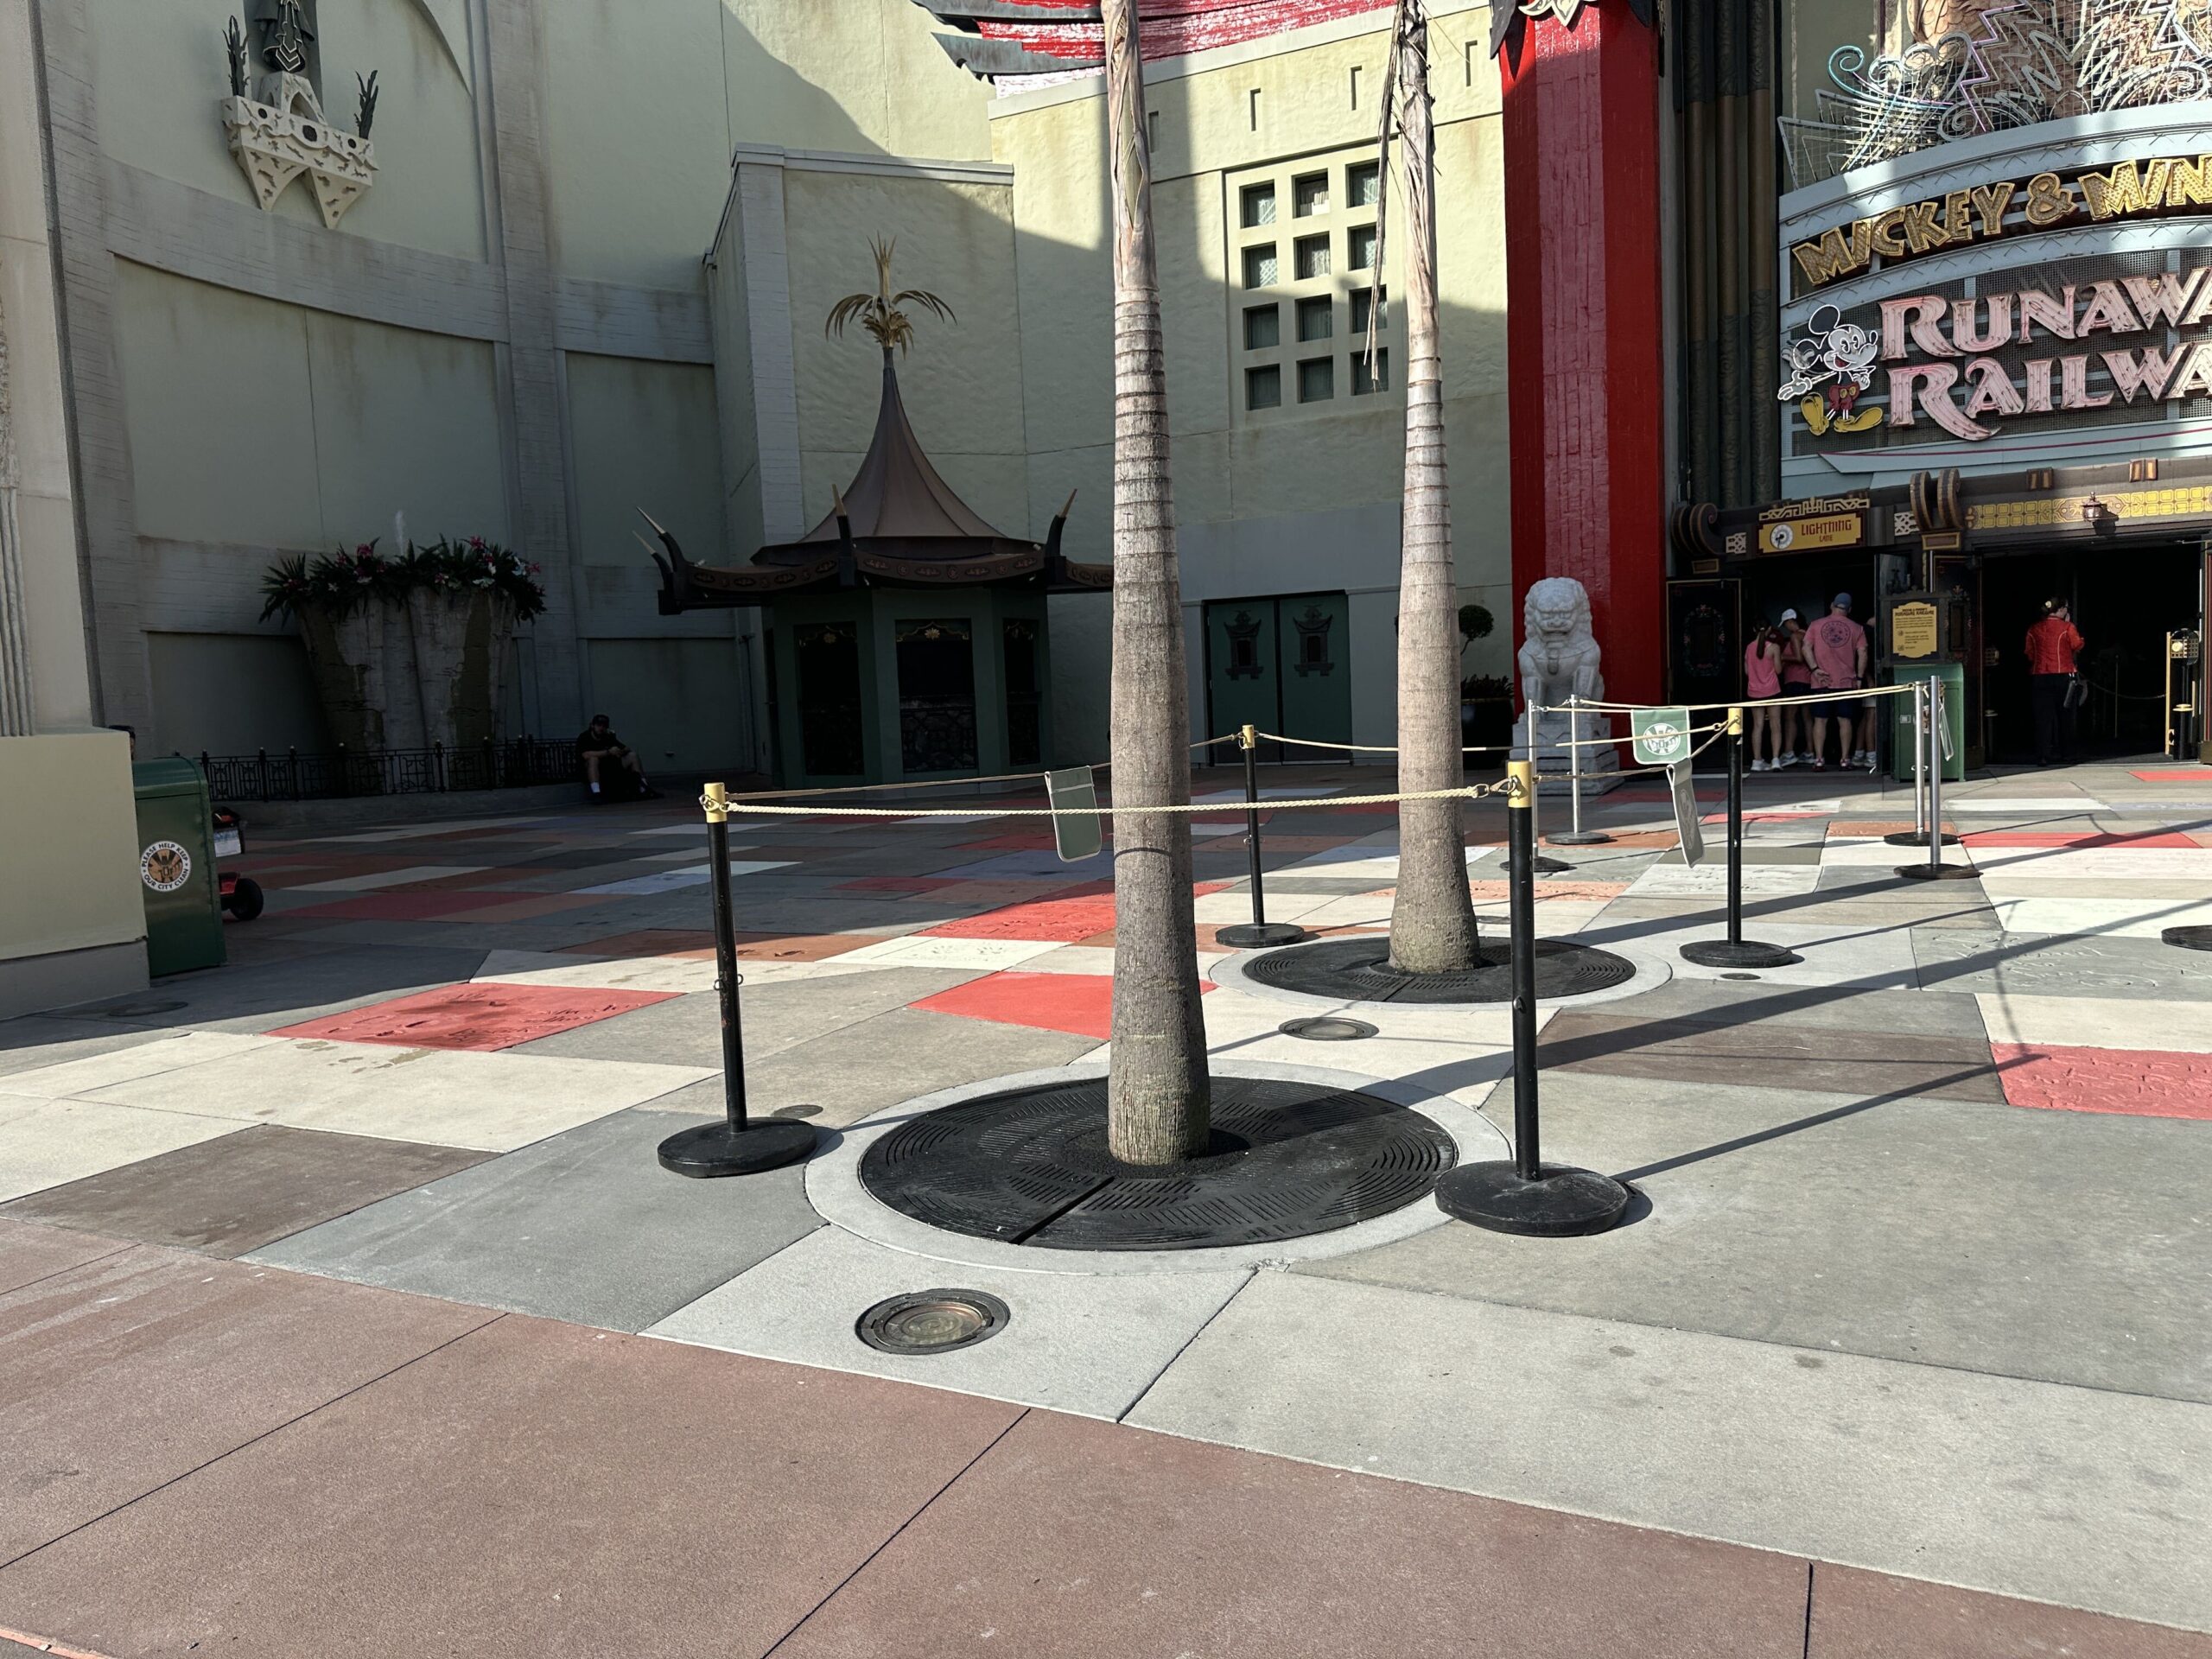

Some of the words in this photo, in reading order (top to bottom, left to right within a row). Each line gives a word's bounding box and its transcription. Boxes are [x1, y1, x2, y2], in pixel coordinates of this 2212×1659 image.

[1791, 181, 2016, 286] MICKEY
[2025, 172, 2078, 226] &
[1801, 519, 1852, 537] LIGHTNING
[1819, 534, 1833, 543] LANE
[141, 846, 157, 868] PLEASE
[175, 847, 188, 861] KEEP
[143, 874, 156, 887] OUR
[174, 868, 189, 887] CLEAN
